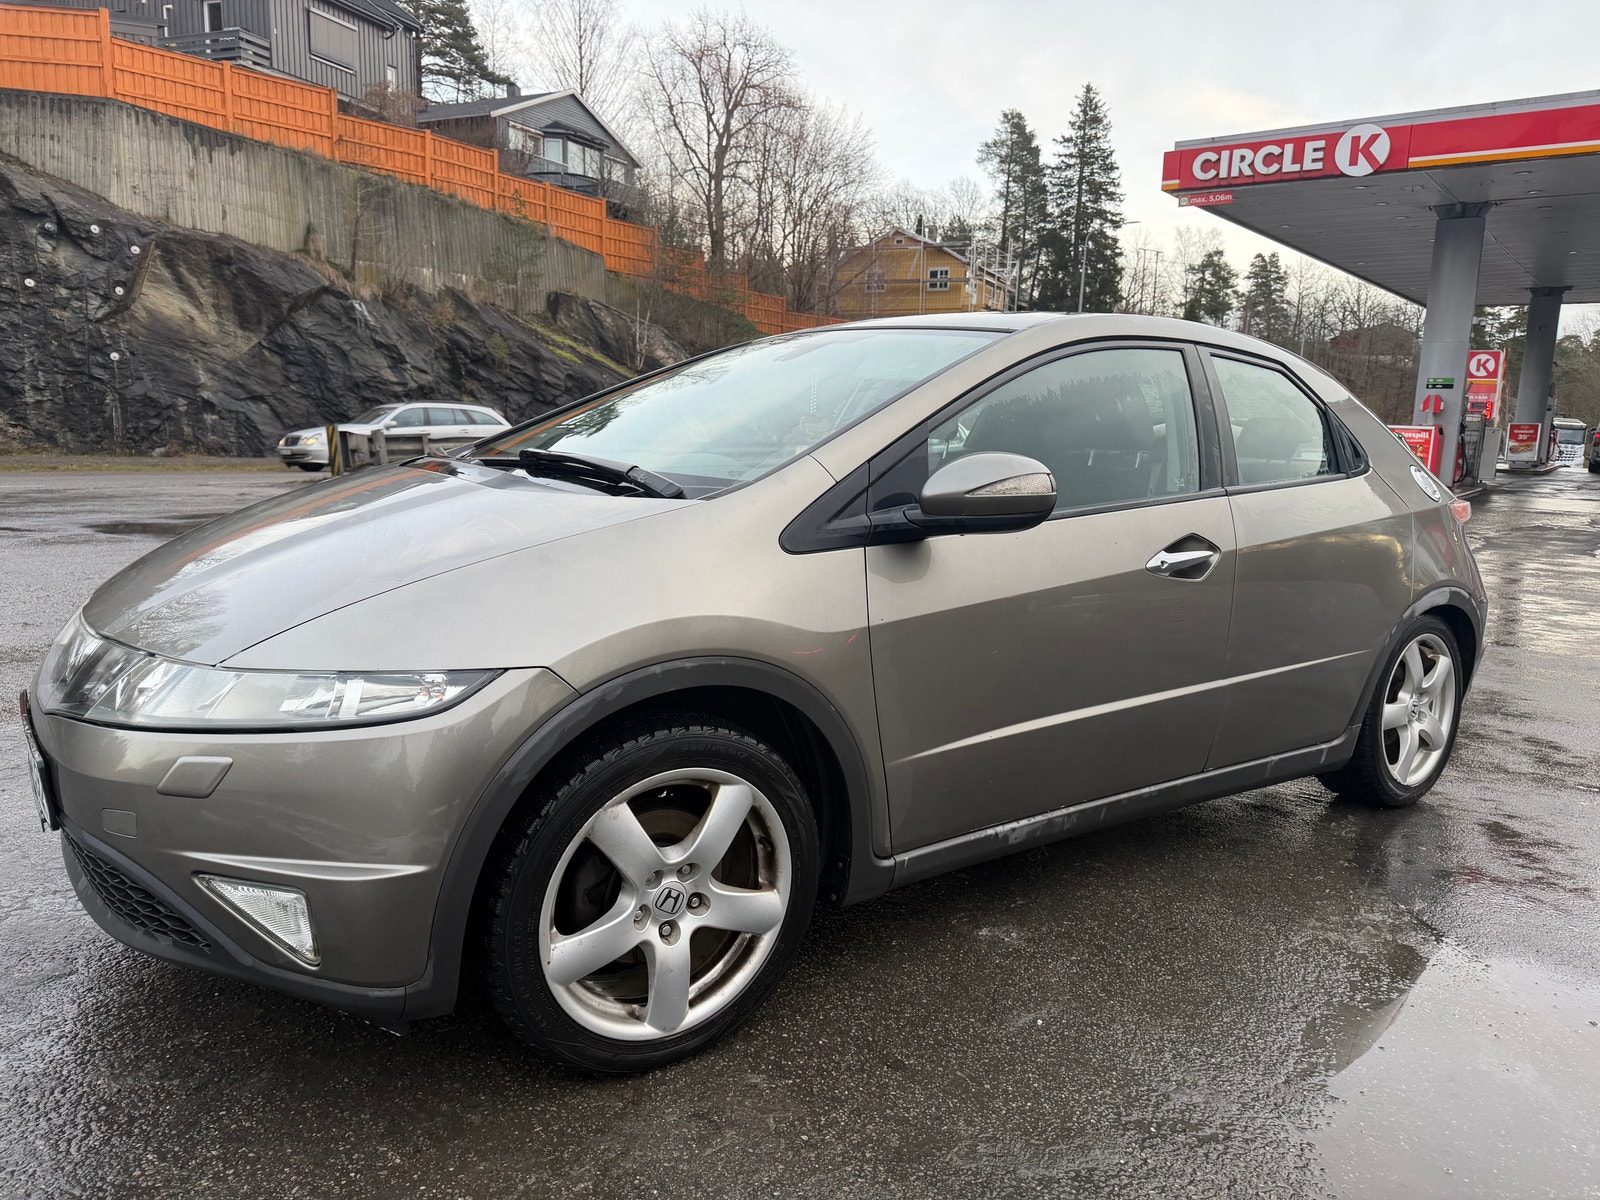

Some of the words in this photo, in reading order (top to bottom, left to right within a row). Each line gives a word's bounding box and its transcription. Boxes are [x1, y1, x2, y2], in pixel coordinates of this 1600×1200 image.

[1192, 139, 1326, 181] CIRCLE
[1346, 131, 1384, 172] K
[1190, 196, 1208, 204] max.
[1474, 357, 1493, 376] K
